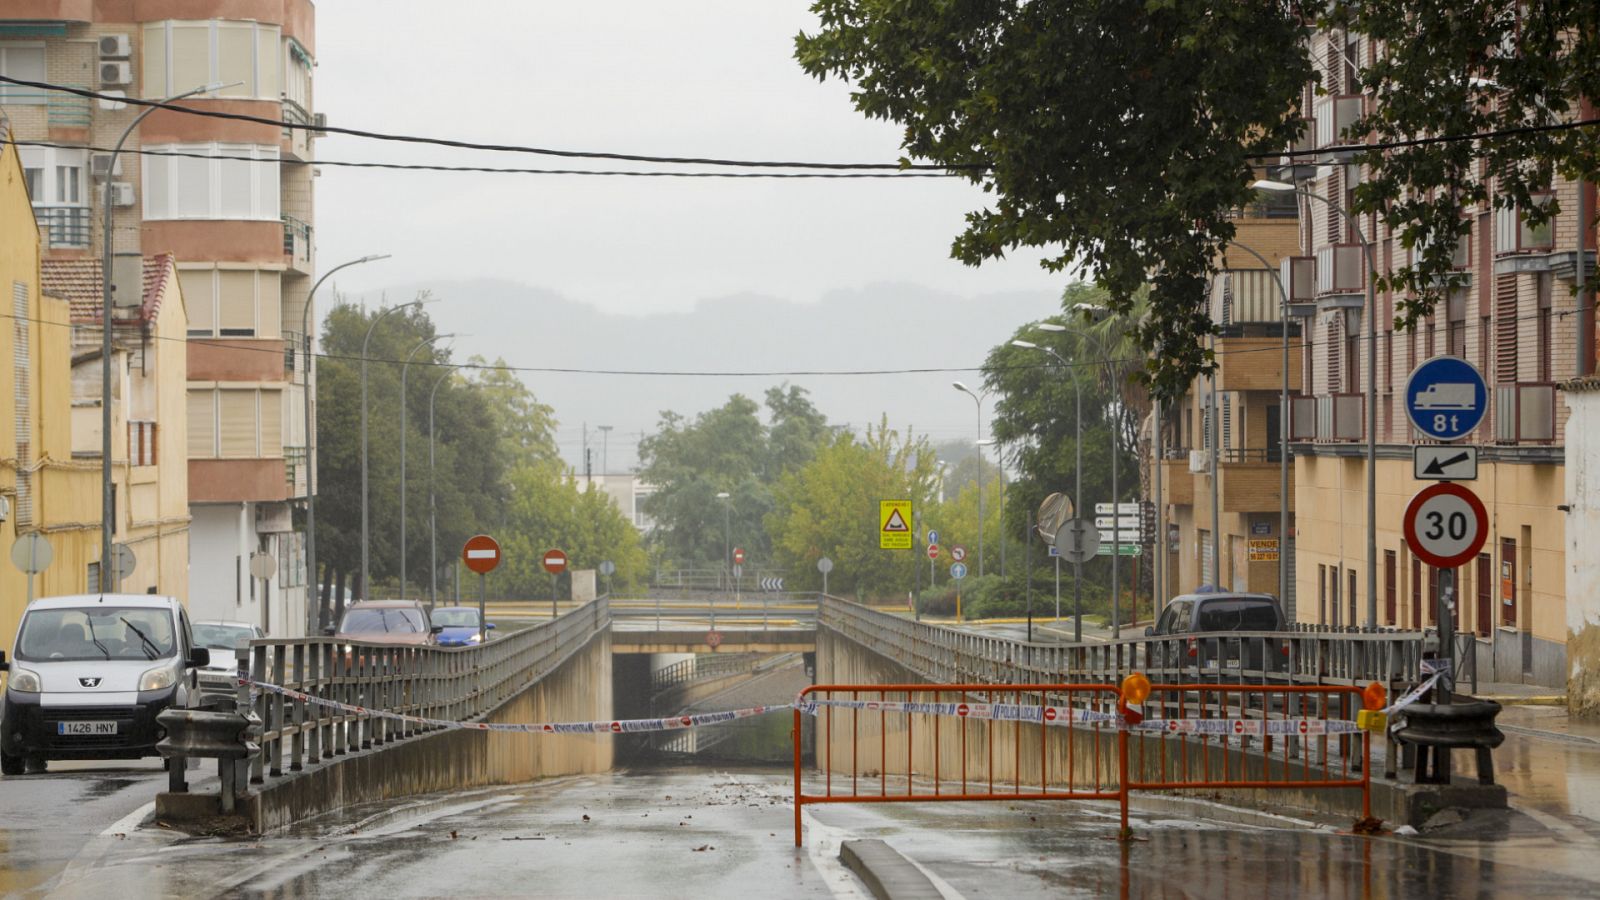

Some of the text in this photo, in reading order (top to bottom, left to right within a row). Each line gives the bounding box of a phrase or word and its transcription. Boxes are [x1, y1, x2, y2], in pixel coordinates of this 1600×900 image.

[1425, 511, 1467, 541] 30
[1250, 540, 1279, 548] VENDE
[1020, 706, 1036, 720] LOCAL
[68, 722, 115, 734] 1426 HNY
